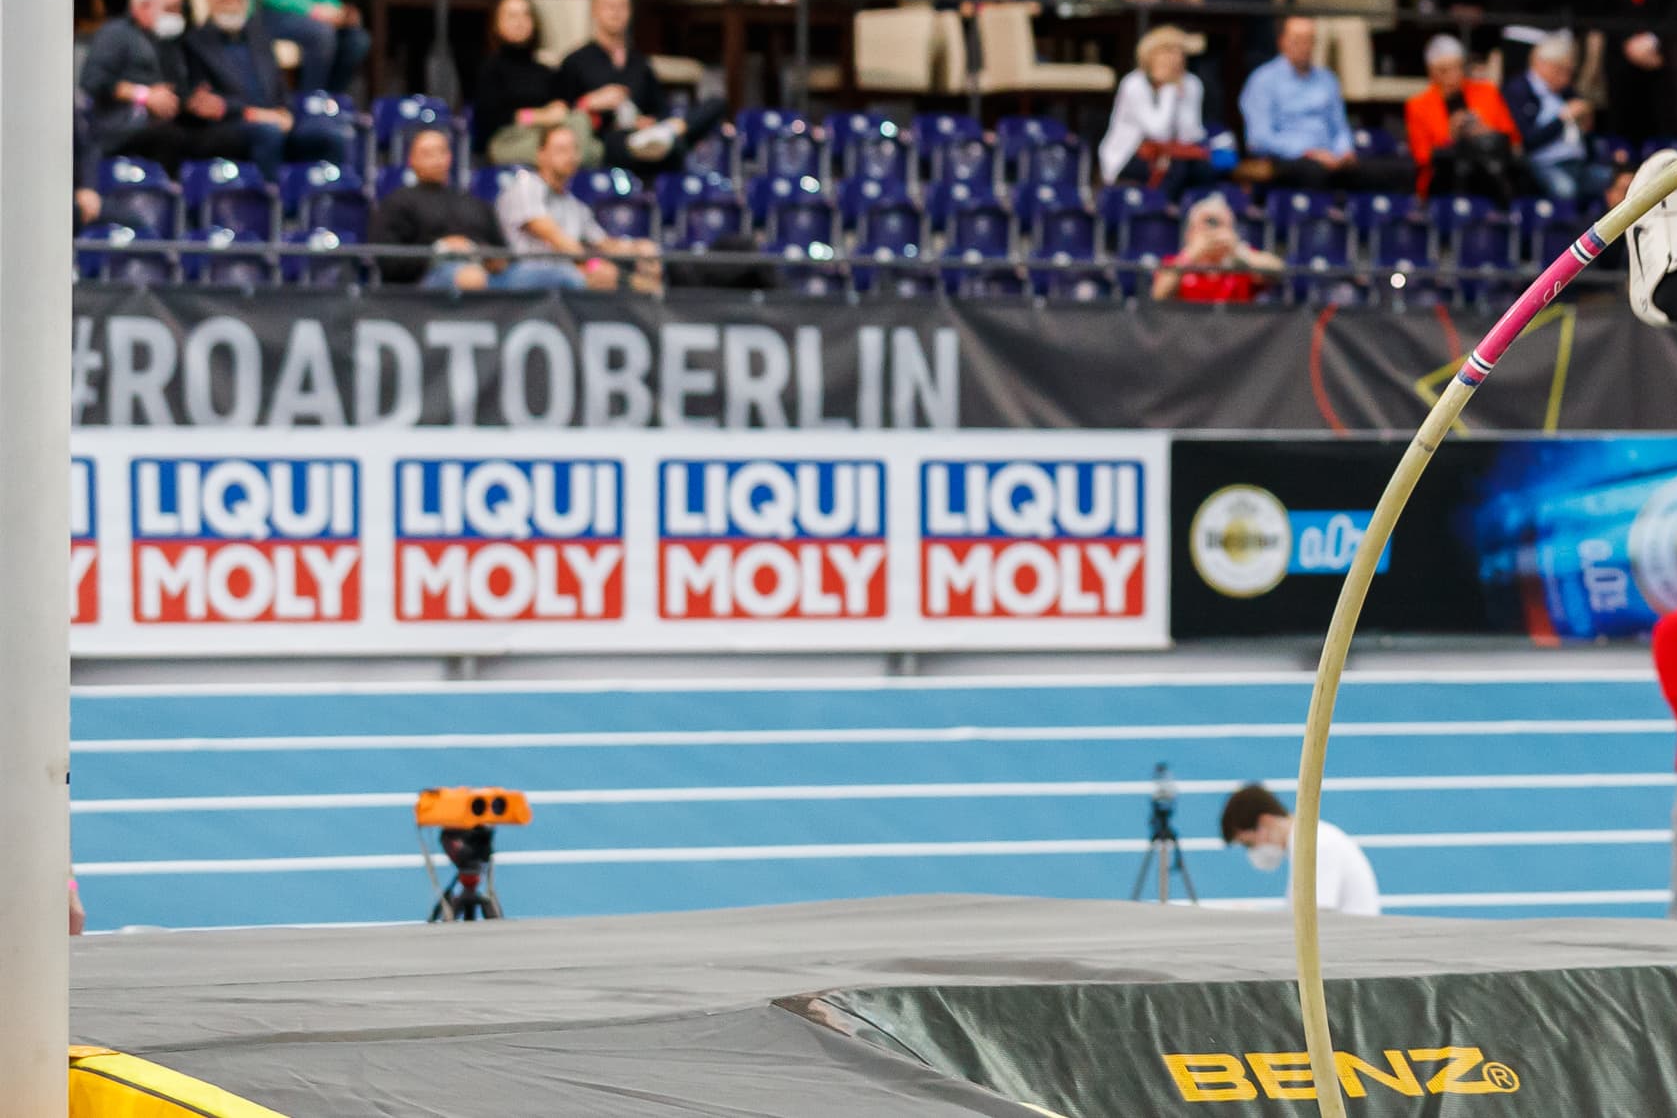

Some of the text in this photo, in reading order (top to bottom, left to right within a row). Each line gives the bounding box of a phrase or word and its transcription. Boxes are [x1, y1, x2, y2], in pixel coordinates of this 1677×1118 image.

[139, 460, 354, 540] LIQUI
[402, 460, 616, 540] LIQUI
[666, 461, 880, 539] LIQUI
[926, 461, 1138, 539] LIQUI
[141, 545, 358, 621] MOLY
[403, 544, 623, 620] MOLY
[667, 543, 885, 618] MOLY
[927, 542, 1144, 617] MOLY
